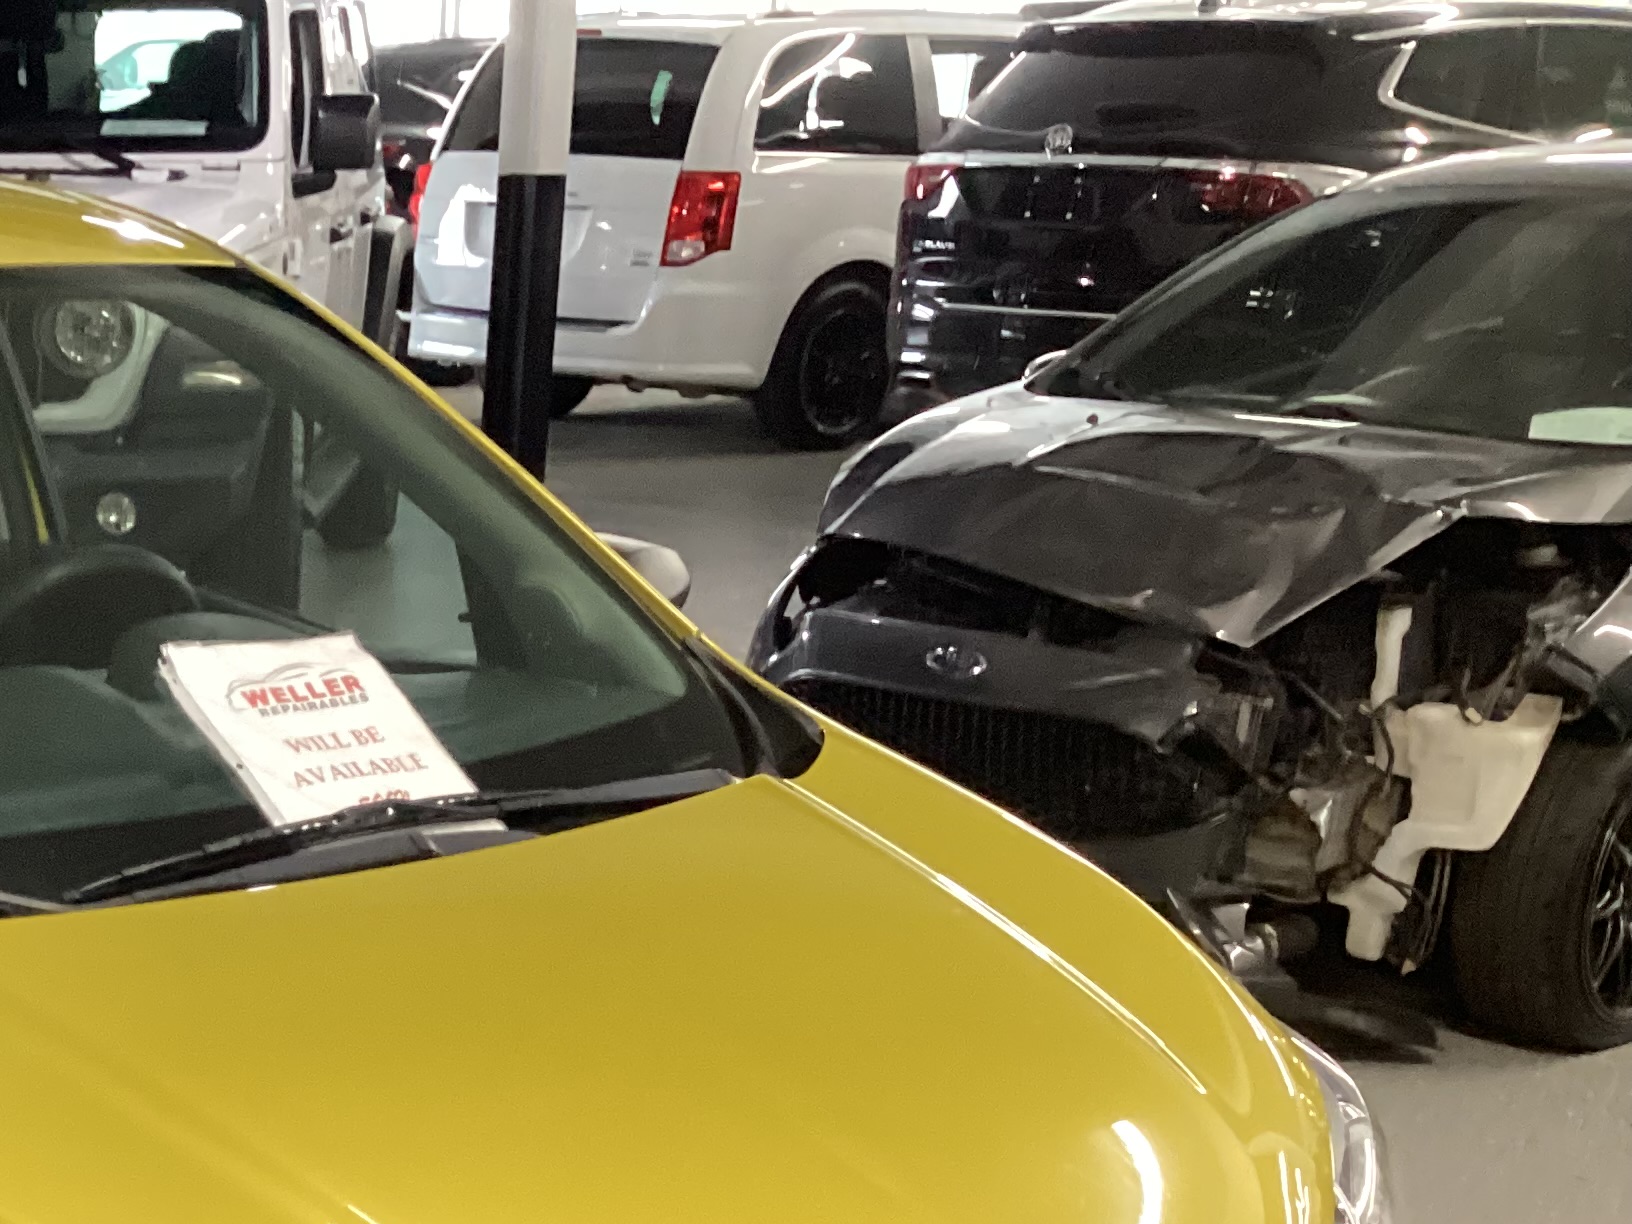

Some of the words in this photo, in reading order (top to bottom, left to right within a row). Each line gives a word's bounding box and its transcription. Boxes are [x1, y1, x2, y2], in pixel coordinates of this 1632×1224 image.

[240, 674, 366, 708] WELLER
[258, 692, 369, 717] REPAIRABLES
[282, 732, 351, 753] WILL
[349, 725, 385, 746] BE
[294, 752, 428, 788] AVAILABLE
